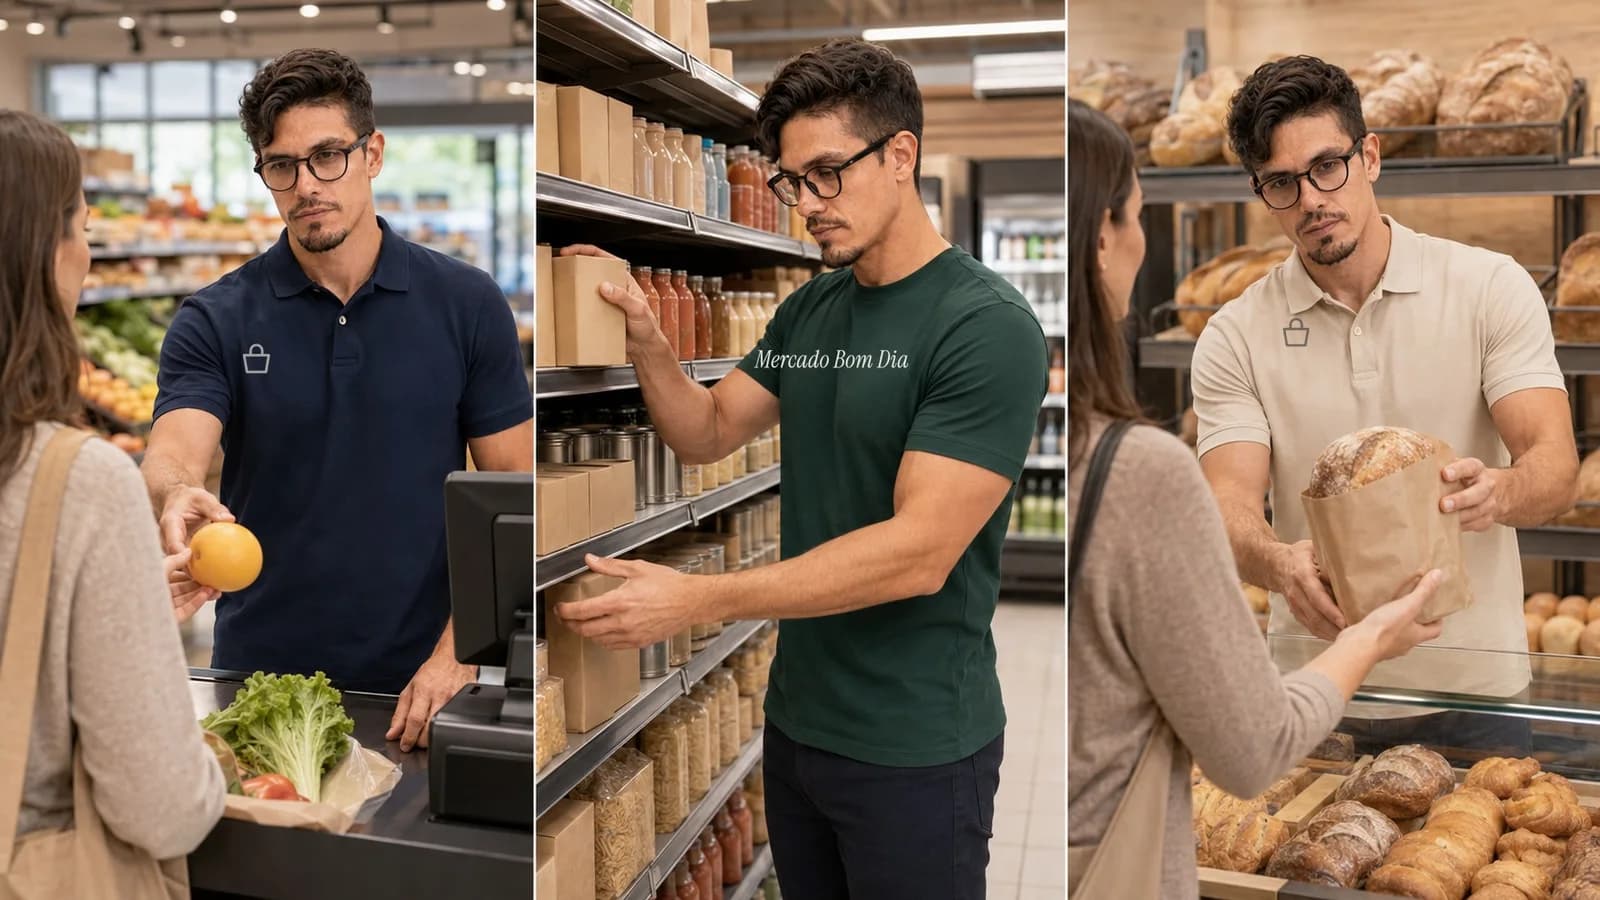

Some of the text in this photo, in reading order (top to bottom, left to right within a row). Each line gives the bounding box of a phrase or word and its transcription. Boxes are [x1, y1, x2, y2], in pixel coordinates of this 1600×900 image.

[754, 349, 909, 369] Mercado Bom Dia
